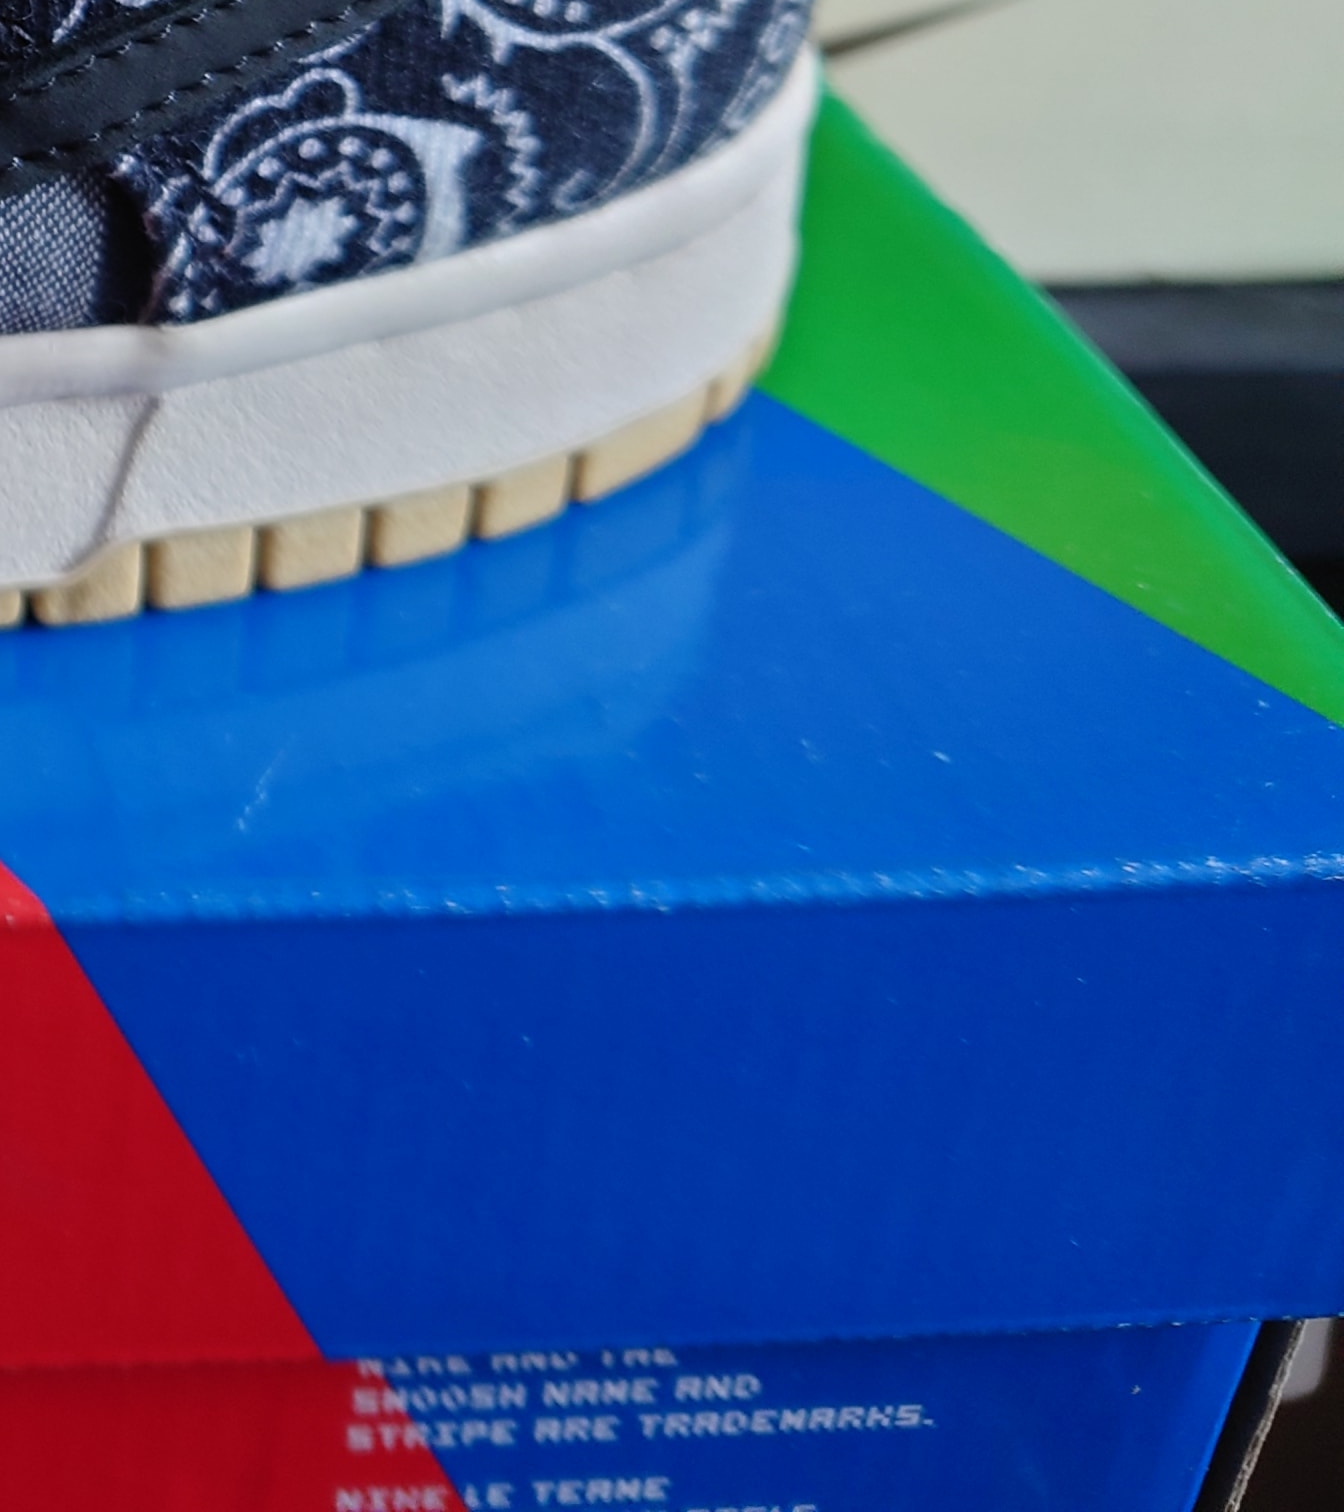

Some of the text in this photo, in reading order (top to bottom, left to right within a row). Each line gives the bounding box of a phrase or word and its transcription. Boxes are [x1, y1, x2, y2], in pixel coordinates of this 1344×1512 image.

[352, 1373, 762, 1415] SWOOSH NAME AND
[346, 1404, 934, 1453] STRIPE ARE TRADEMARKS.
[533, 1476, 670, 1506] TERME
